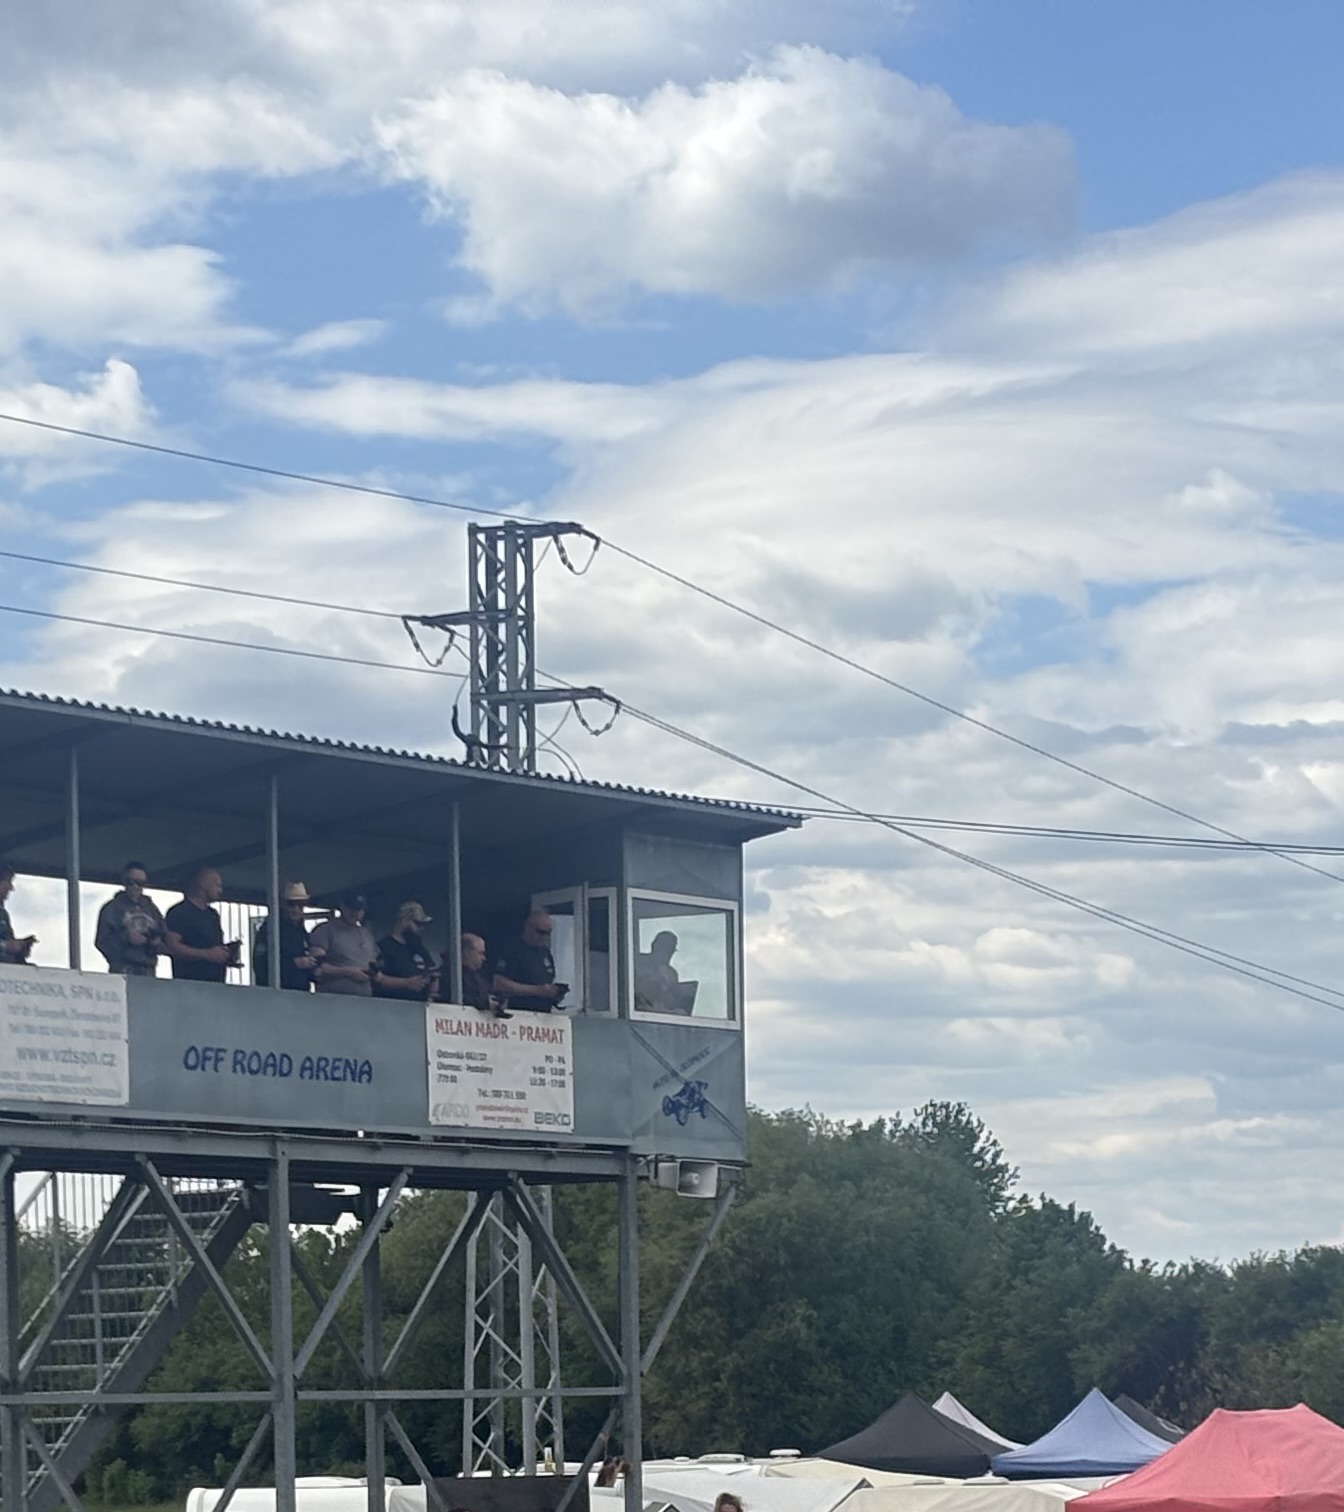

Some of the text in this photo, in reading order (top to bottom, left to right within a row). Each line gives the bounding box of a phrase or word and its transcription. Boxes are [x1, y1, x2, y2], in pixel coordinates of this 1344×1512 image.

[435, 1018, 472, 1037] MILAN
[476, 1022, 509, 1041] MADR
[519, 1026, 564, 1045] PRAMAT
[182, 1045, 373, 1084] OFF ROAD ARENA
